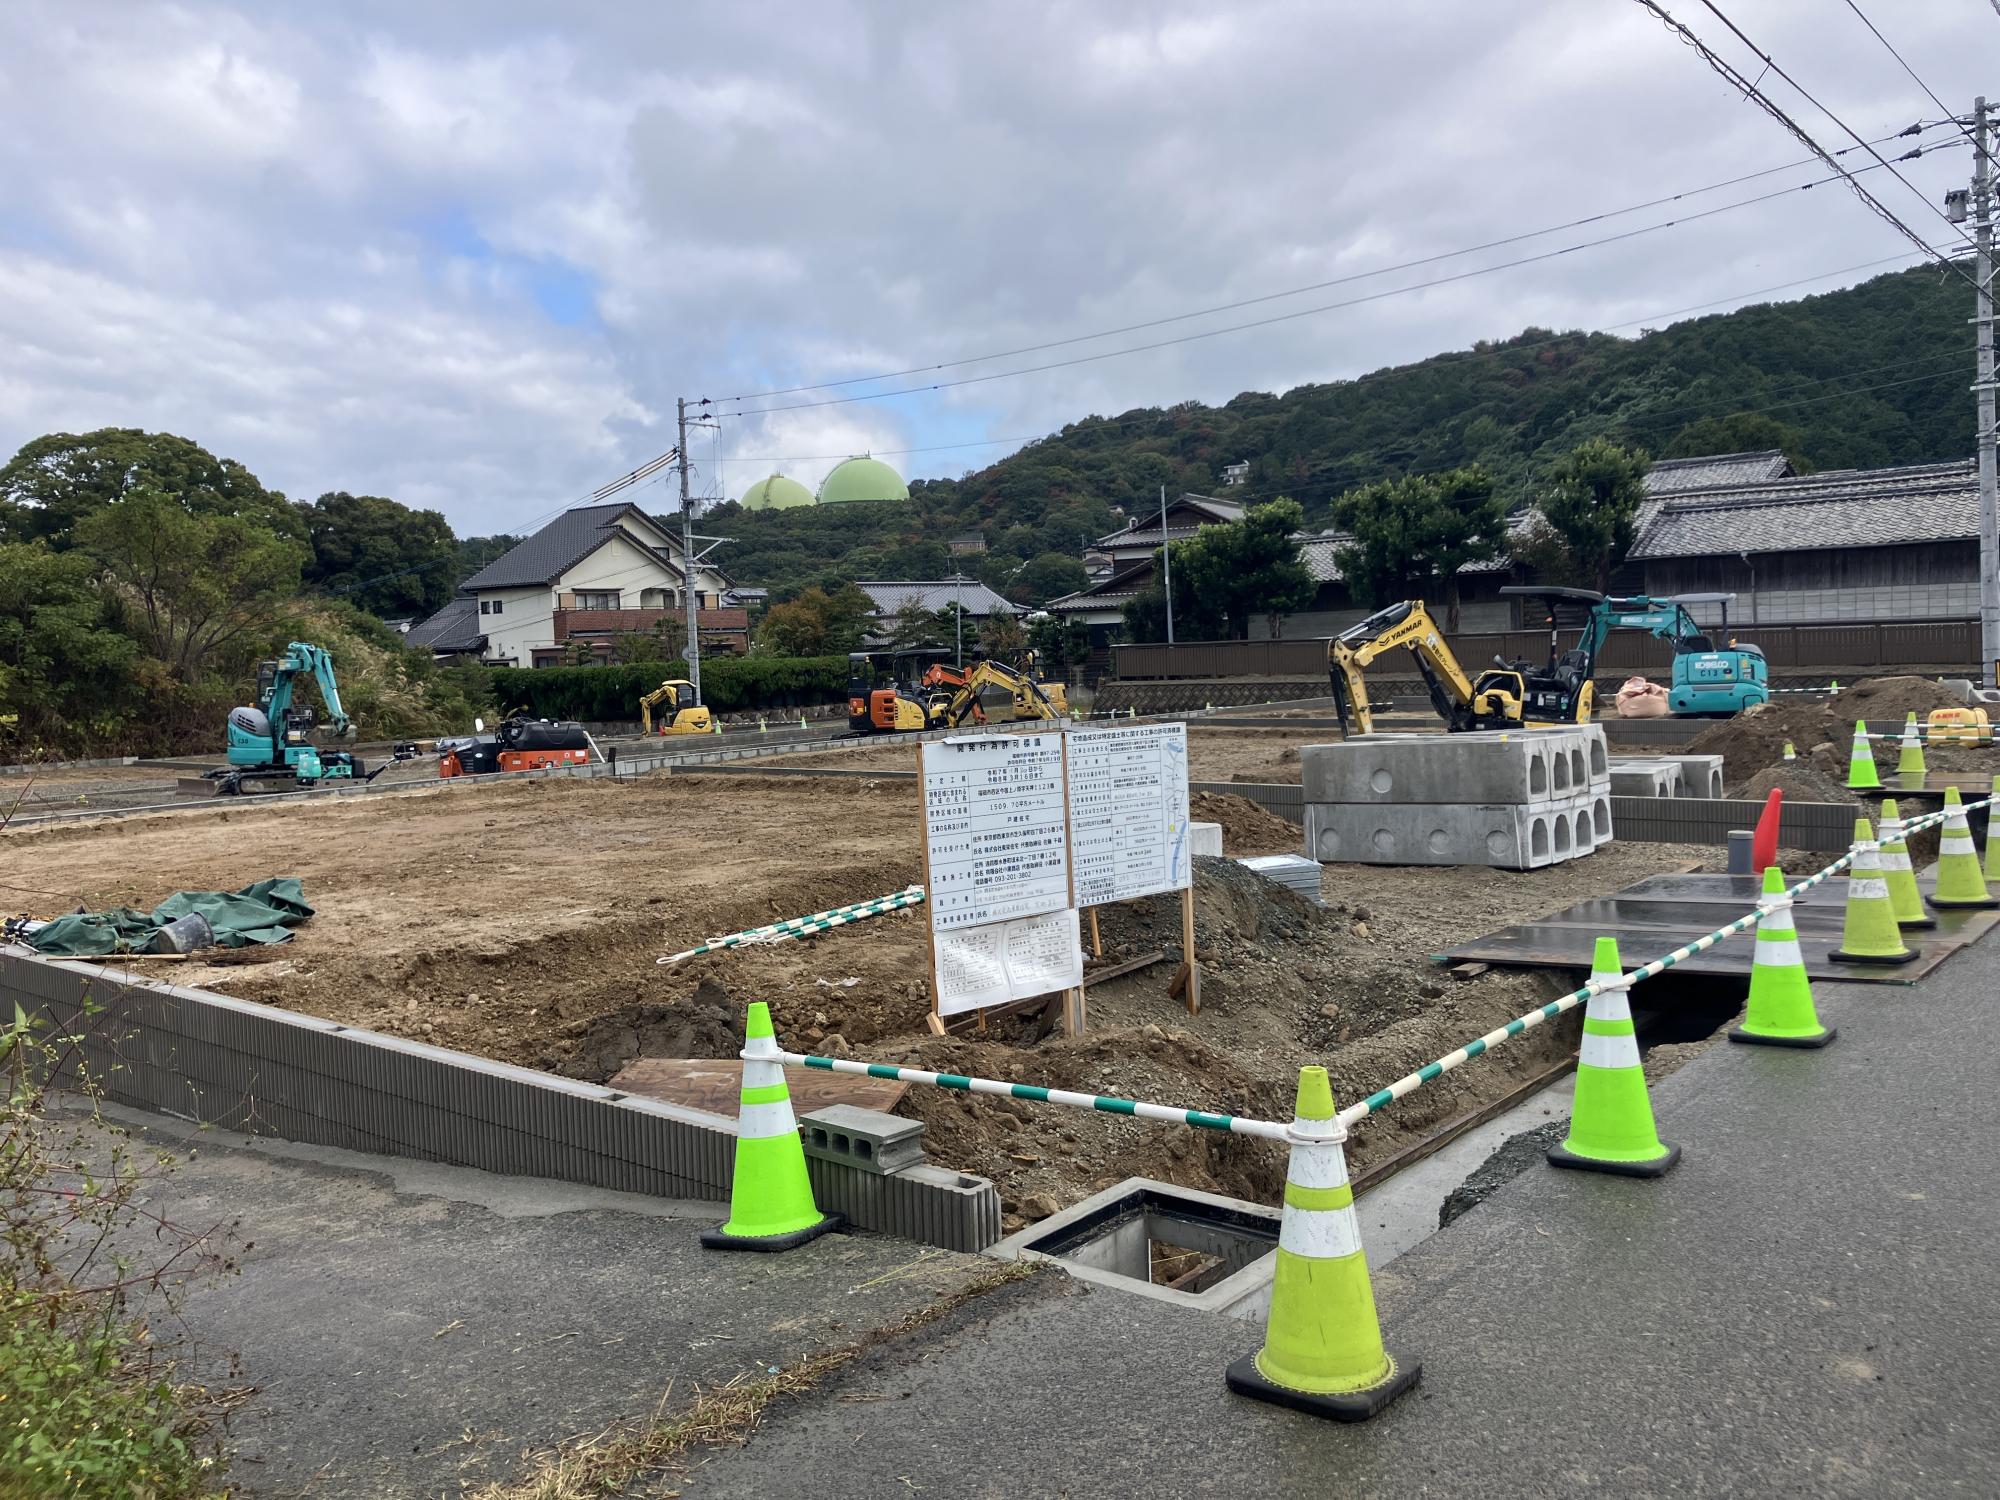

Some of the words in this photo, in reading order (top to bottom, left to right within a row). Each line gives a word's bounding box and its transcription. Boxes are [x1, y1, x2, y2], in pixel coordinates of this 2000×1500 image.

[1391, 620, 1422, 640] YANMAR
[1007, 815, 1029, 823] 戸建住宅
[994, 871, 1031, 882] 093-201-3802
